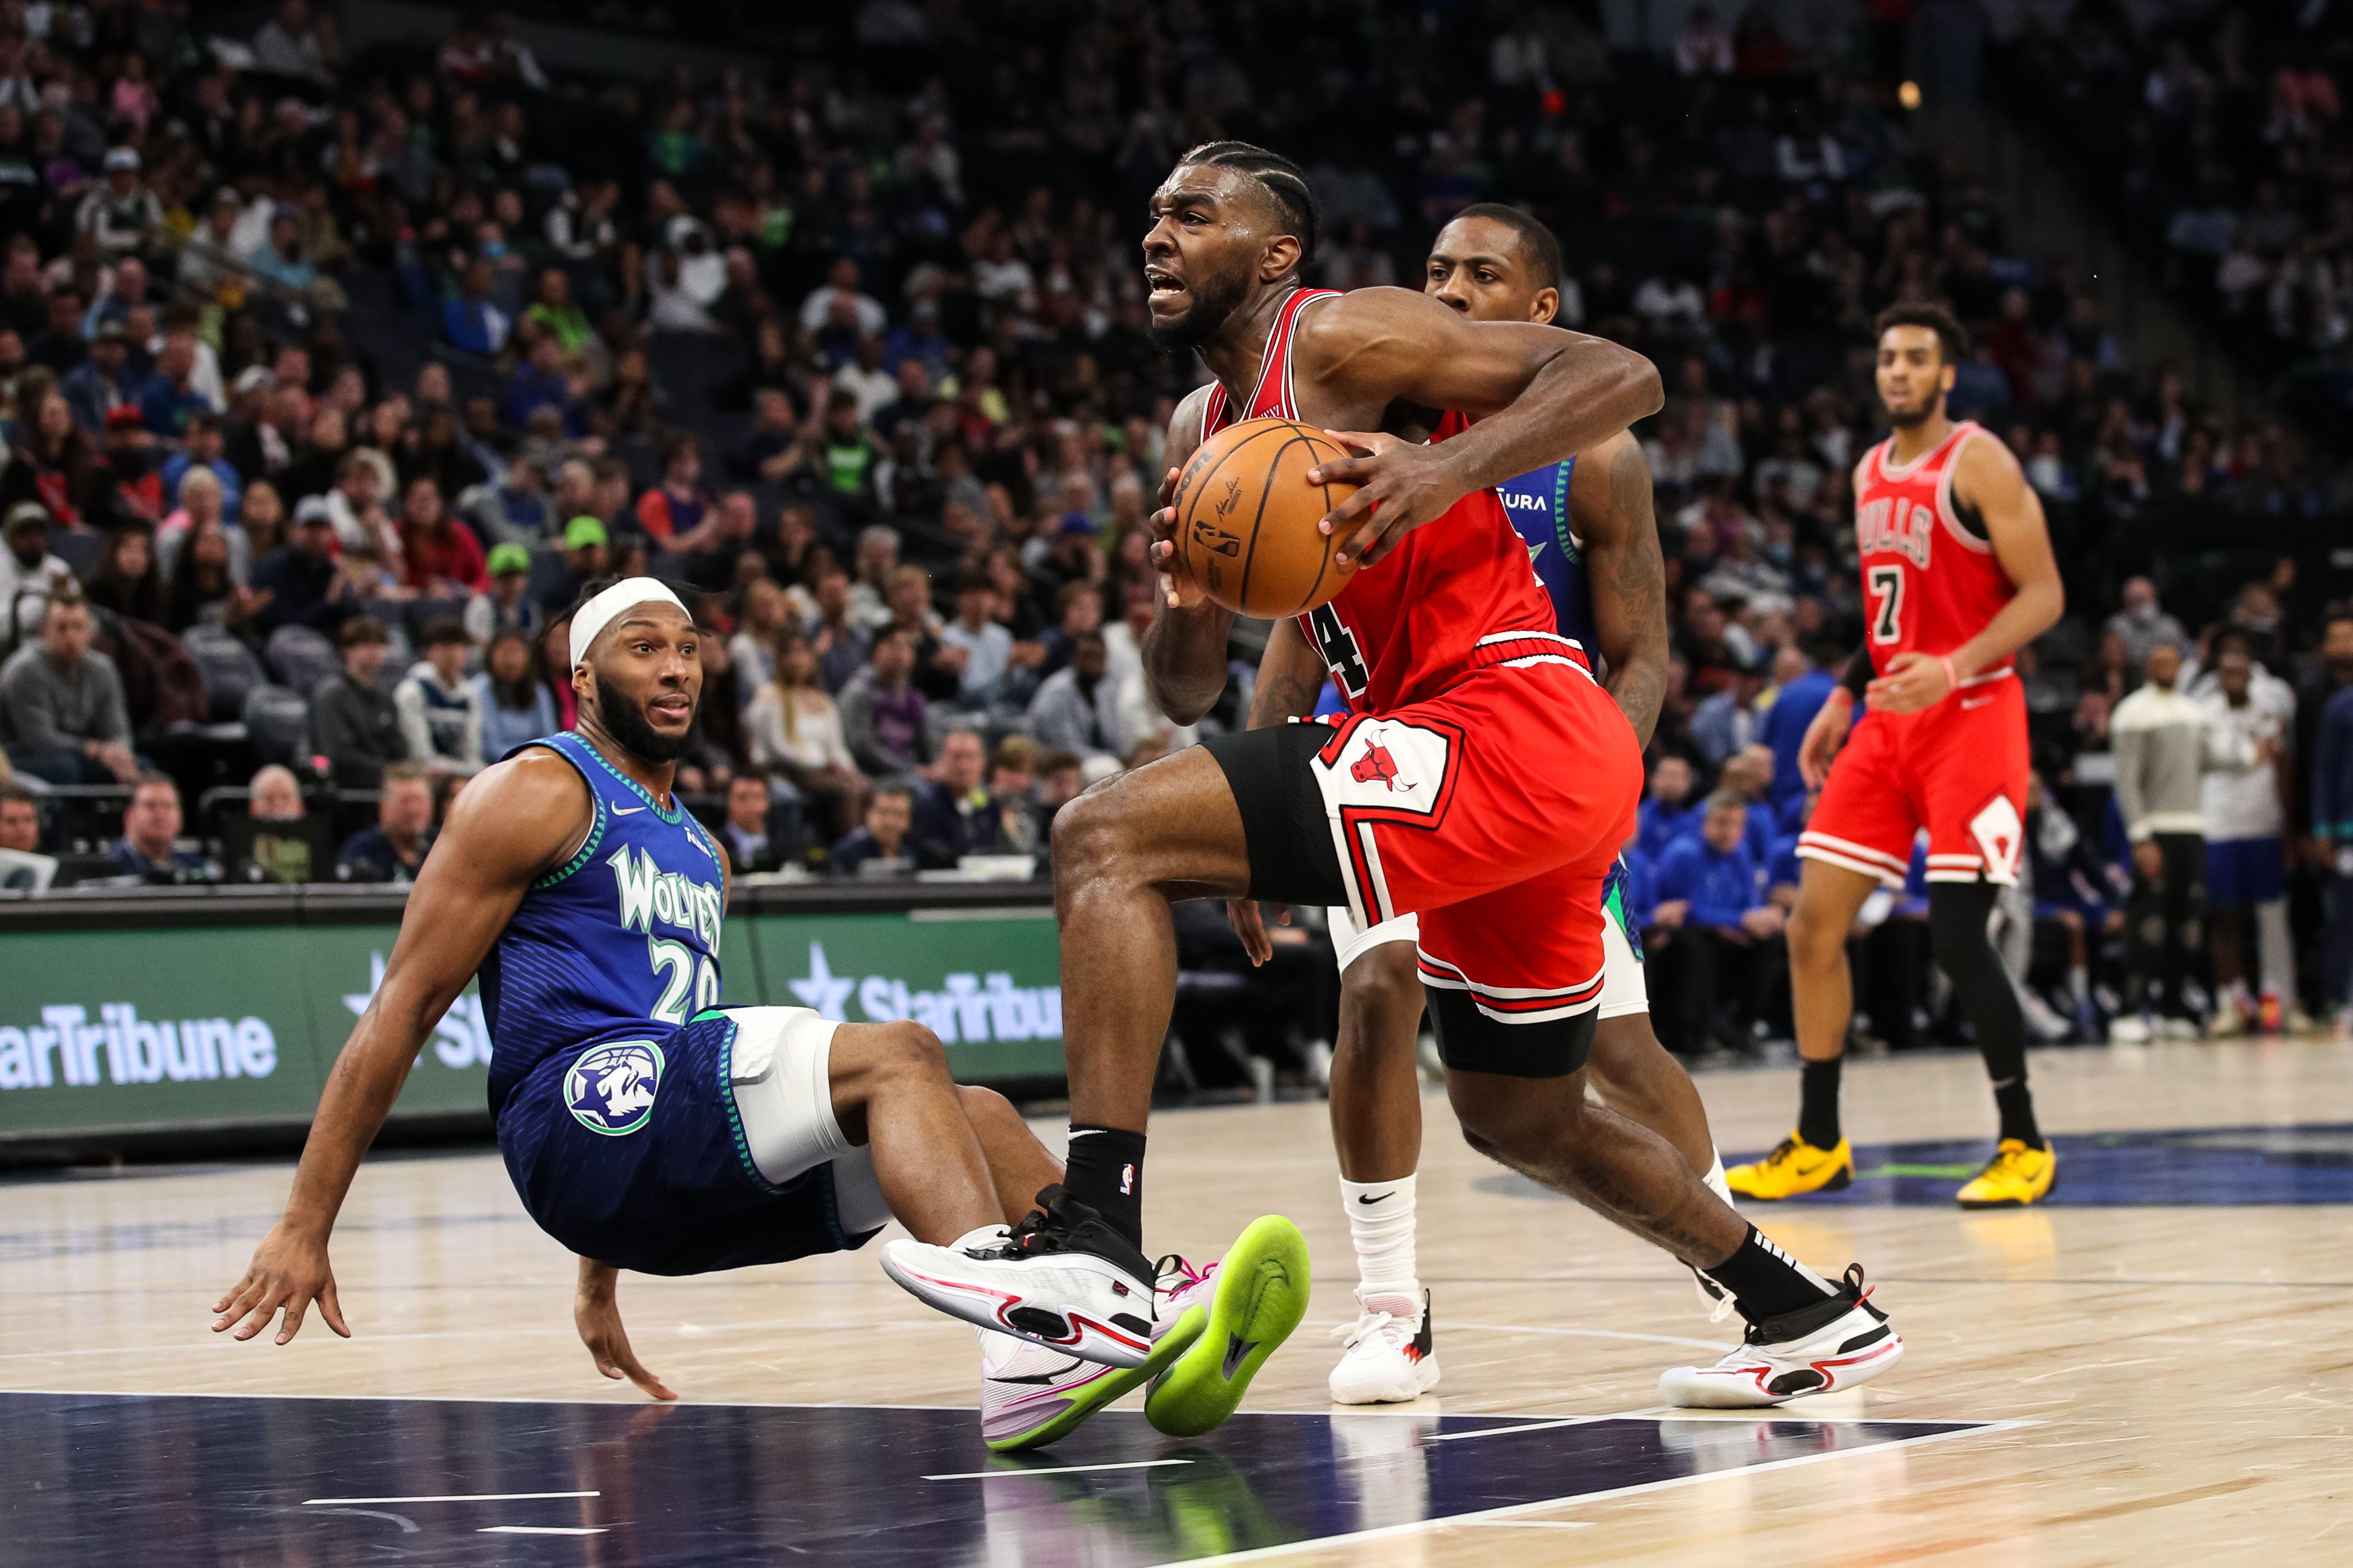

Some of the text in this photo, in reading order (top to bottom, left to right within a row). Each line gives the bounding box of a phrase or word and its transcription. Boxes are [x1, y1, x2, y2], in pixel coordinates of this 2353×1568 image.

[1868, 563, 1906, 645] 7
[1309, 601, 1370, 700] 4
[648, 933, 718, 1027] 20
[859, 970, 1062, 1044] StarTribu
[0, 1001, 277, 1090] arTribune
